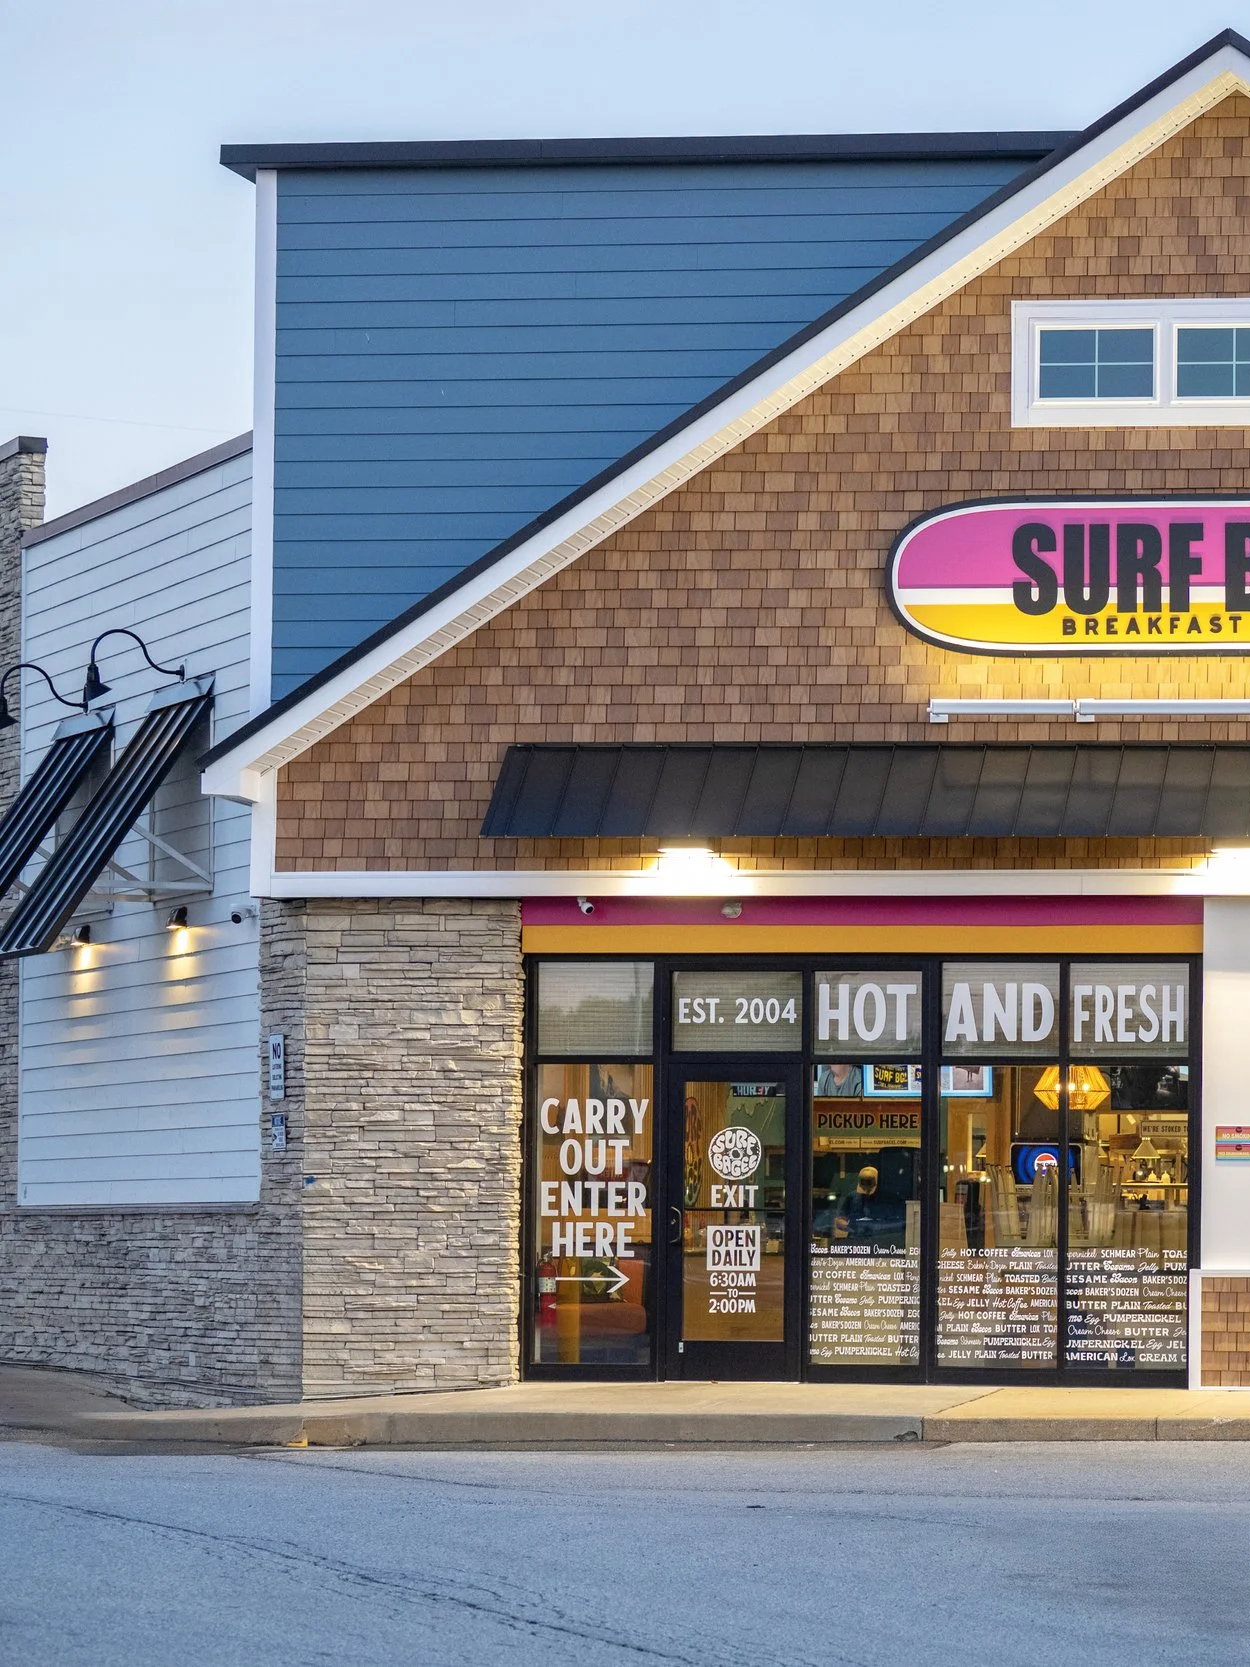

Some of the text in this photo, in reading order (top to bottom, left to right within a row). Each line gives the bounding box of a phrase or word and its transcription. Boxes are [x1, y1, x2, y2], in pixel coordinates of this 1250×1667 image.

[1012, 521, 1204, 616] SURF
[1062, 614, 1242, 636] BREAKFAST
[679, 998, 797, 1024] EST. 2004
[818, 982, 1184, 1043] HOT AND FRESH
[272, 1043, 281, 1059] NO
[540, 1098, 649, 1134] CARRY
[818, 1113, 918, 1129] PICKUP HERE
[712, 1130, 757, 1155] SURF
[560, 1139, 629, 1175] OUT
[713, 1153, 757, 1177] BAGEL
[541, 1181, 647, 1216] ENTER
[711, 1185, 758, 1208] EXIT
[552, 1222, 635, 1257] HERE
[712, 1229, 756, 1248] OPEN
[712, 1250, 756, 1266] DAILY
[979, 1249, 1008, 1257] COFFEE
[1101, 1250, 1135, 1258] SCHMEAR
[710, 1272, 756, 1287] 6:30AM
[1005, 1274, 1040, 1283] TOASTED
[1066, 1275, 1172, 1284] SESAME BAKER'S
[728, 1288, 738, 1298] TO
[949, 1286, 1035, 1295] SESAME BAKER'S
[1085, 1288, 1139, 1296] BAKER'S DOZEN
[709, 1299, 756, 1313] 2:00PM
[967, 1299, 989, 1307] JELLY
[1066, 1301, 1107, 1309] BUTTER
[1111, 1301, 1140, 1310] PLAIN
[958, 1311, 1006, 1320] HOT COFFEE
[1103, 1314, 1181, 1323] PUMPERNICKEL
[946, 1324, 1026, 1333] PLAIN BUTTER
[1125, 1328, 1169, 1336] BUTTER
[983, 1338, 1041, 1346] PUMPERNICKEL
[948, 1350, 971, 1358] JELLY
[1022, 1351, 1052, 1359] BUTTER
[1139, 1354, 1177, 1362] CREAM
